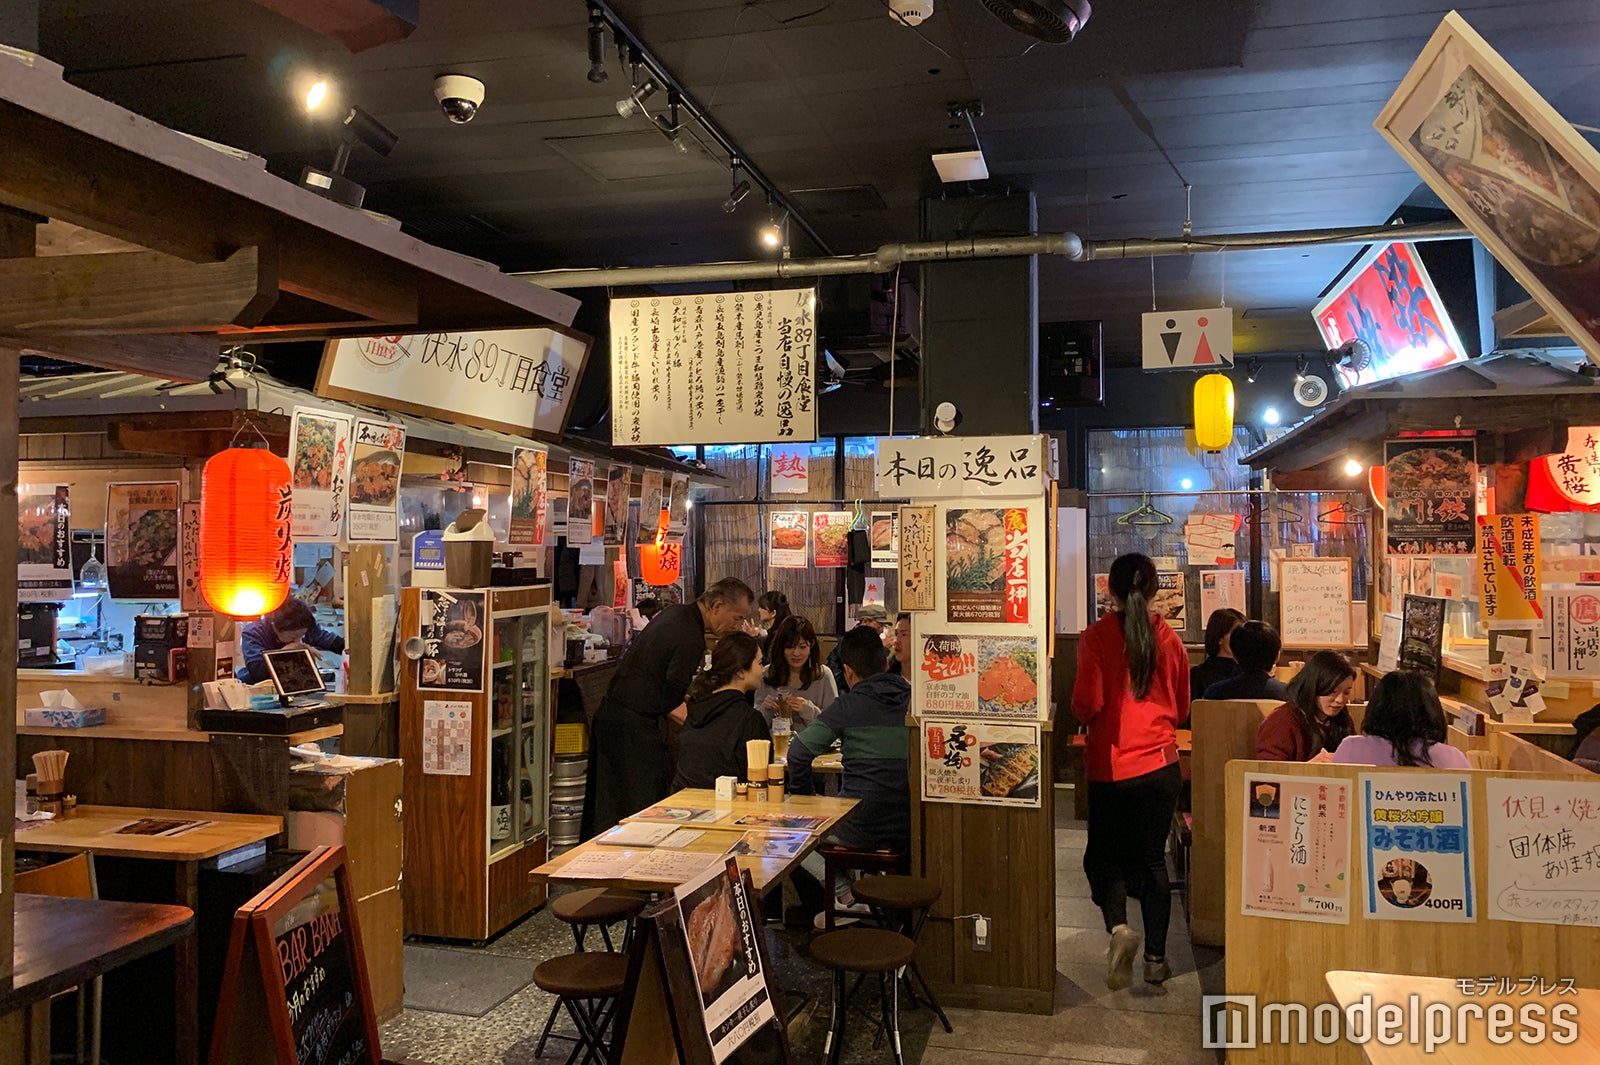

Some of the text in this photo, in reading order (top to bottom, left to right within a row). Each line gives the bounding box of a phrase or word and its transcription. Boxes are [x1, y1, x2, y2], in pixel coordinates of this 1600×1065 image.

[421, 332, 570, 401] 伏水89丁目食堂
[776, 317, 794, 437] 当店自慢の逸品
[794, 291, 813, 413] 伏水89丁目食堂
[883, 445, 1038, 487] 本日の逸品
[1557, 454, 1591, 495] 黄桜
[1500, 515, 1516, 567] 飲酒運転
[1521, 515, 1537, 601] 未成年者の飲酒
[1004, 530, 1028, 619] 当店一押し
[1482, 525, 1497, 616] 禁止されています
[1573, 627, 1587, 671] いち押し
[1588, 625, 1600, 658] 当店の
[1258, 823, 1276, 833] 新酒
[1290, 796, 1308, 865] にごり酒
[1372, 826, 1461, 851] みぞれ酒
[1374, 809, 1443, 824] 黄桜大吟醸
[1509, 828, 1576, 860] 団体席
[732, 881, 757, 975] 本日のおすすめ
[1425, 898, 1463, 911] 400円
[277, 926, 312, 986] BAR
